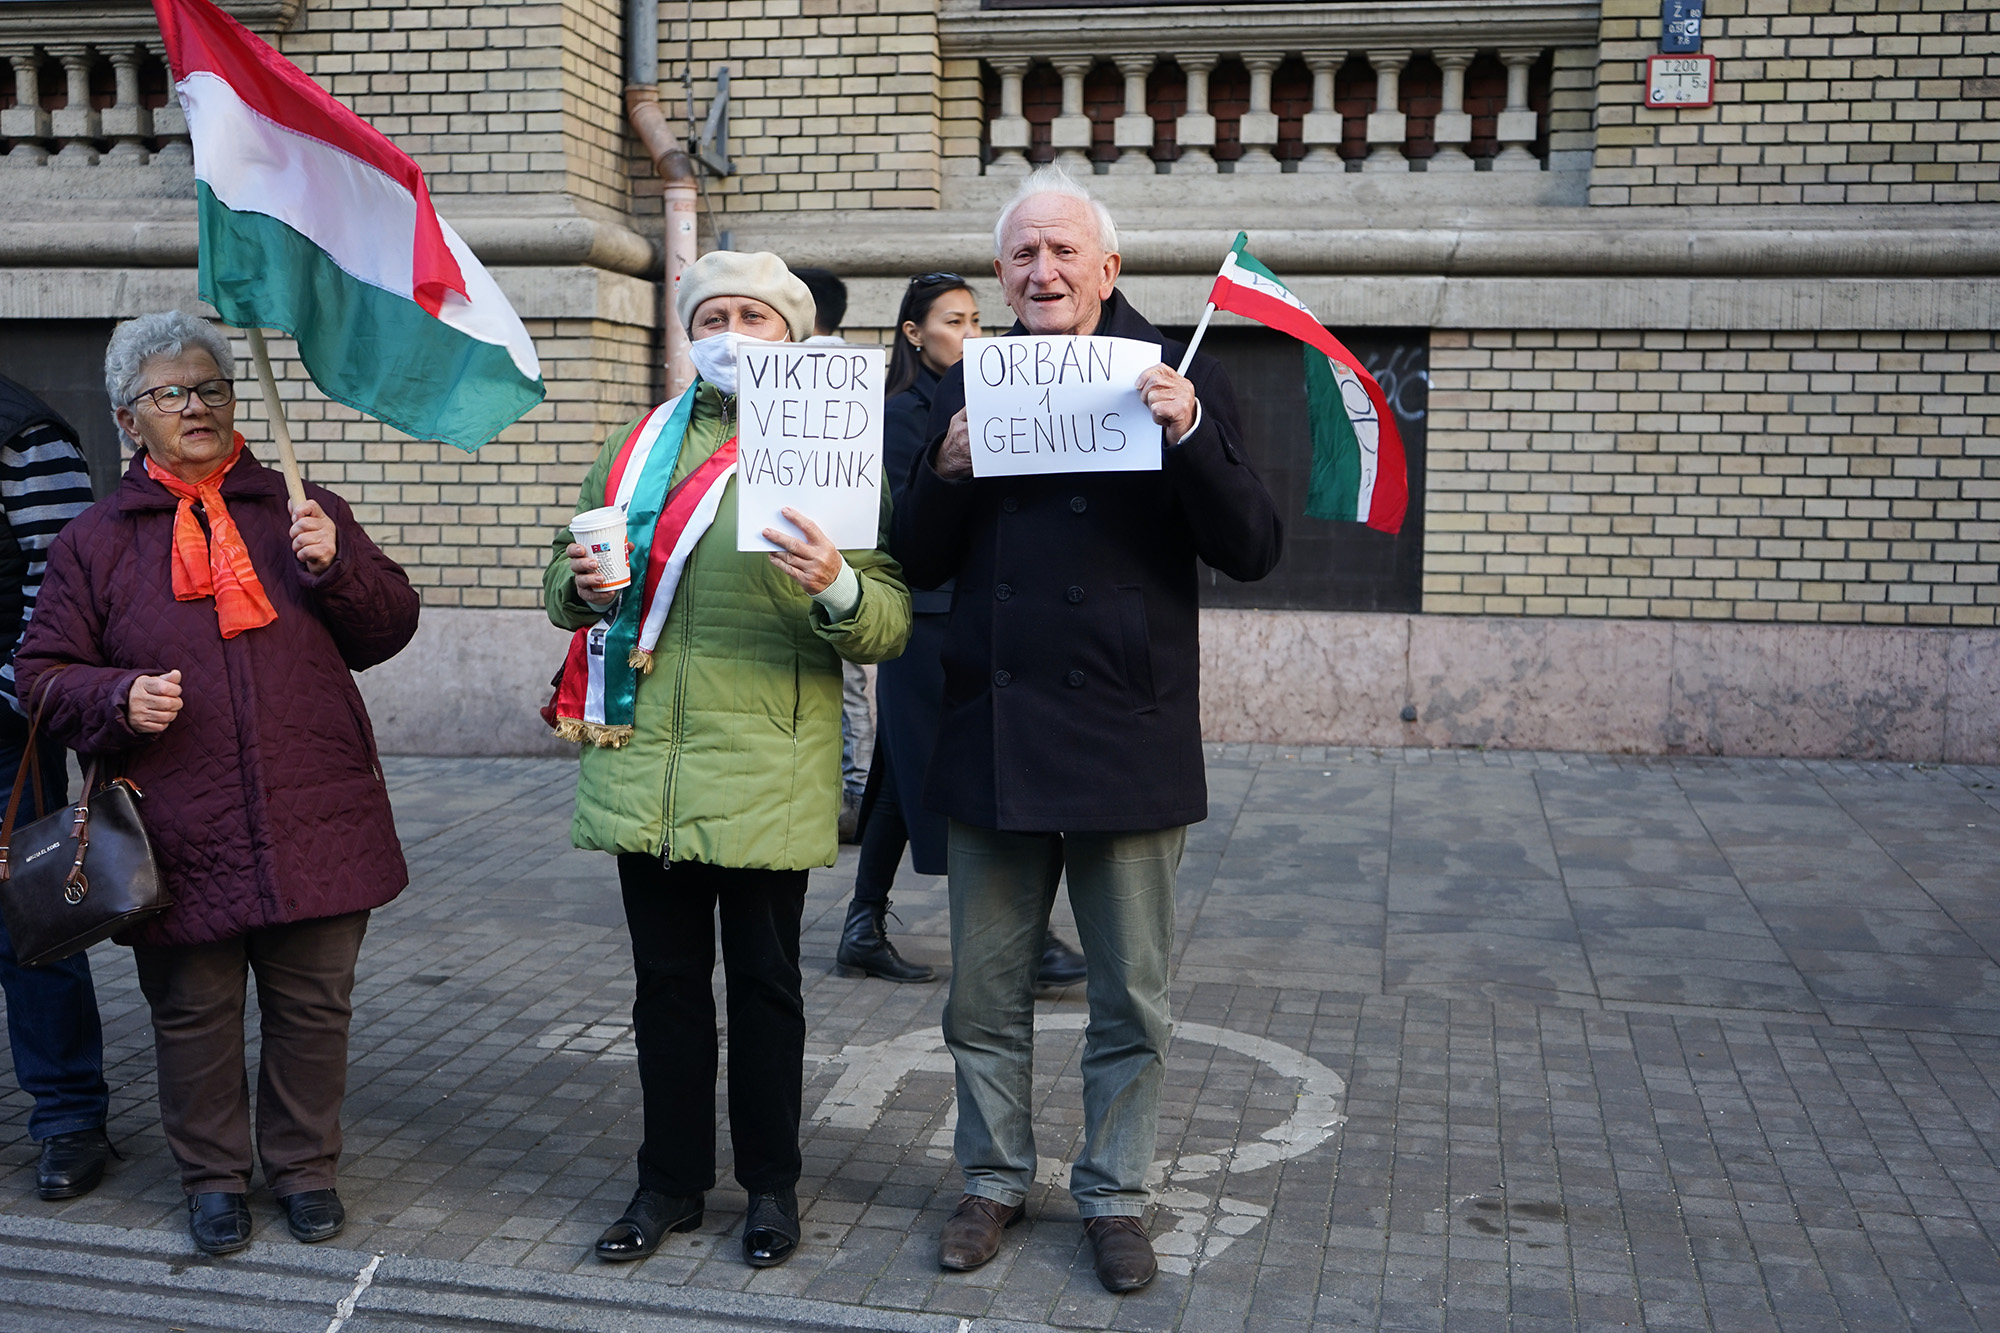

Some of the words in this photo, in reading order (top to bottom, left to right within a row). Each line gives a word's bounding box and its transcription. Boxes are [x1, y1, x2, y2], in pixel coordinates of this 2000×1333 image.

[746, 353, 868, 391] VIKTOR
[980, 336, 1113, 387] ORBÁN
[750, 400, 869, 440] VELED
[1039, 388, 1051, 413] 1
[983, 407, 1126, 453] GÉNIUS
[741, 448, 875, 488] VAGYUNK
